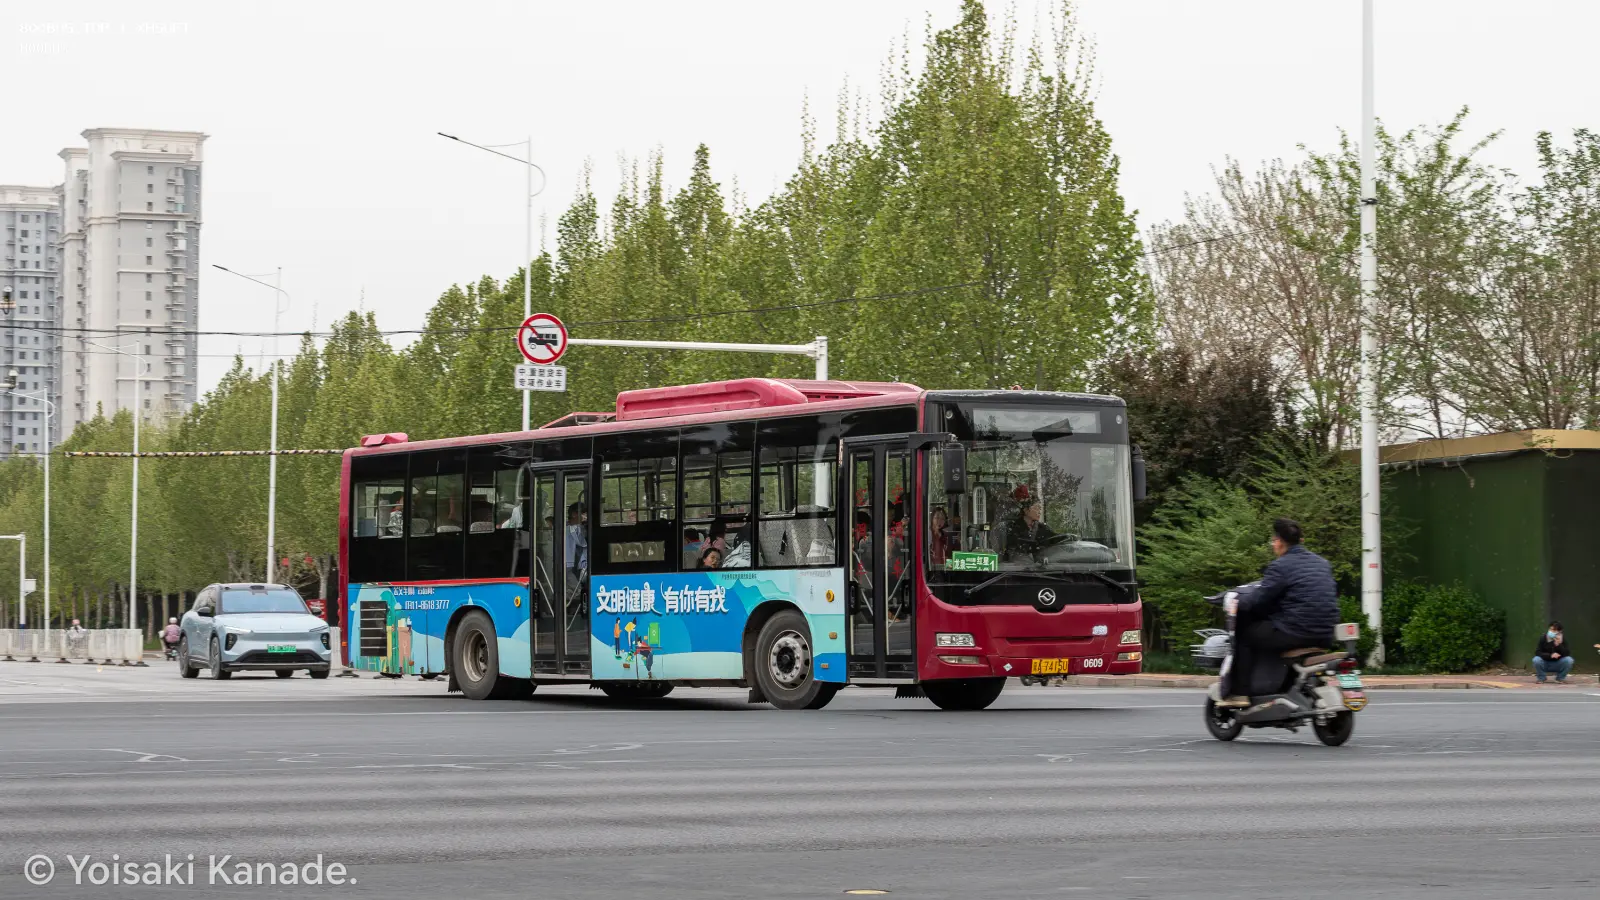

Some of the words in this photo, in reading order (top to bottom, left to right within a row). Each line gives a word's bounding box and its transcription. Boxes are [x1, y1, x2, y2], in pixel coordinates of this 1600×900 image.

[596, 581, 663, 616] 文明健康
[660, 580, 730, 615] 有你有我
[1083, 658, 1103, 668] 0609
